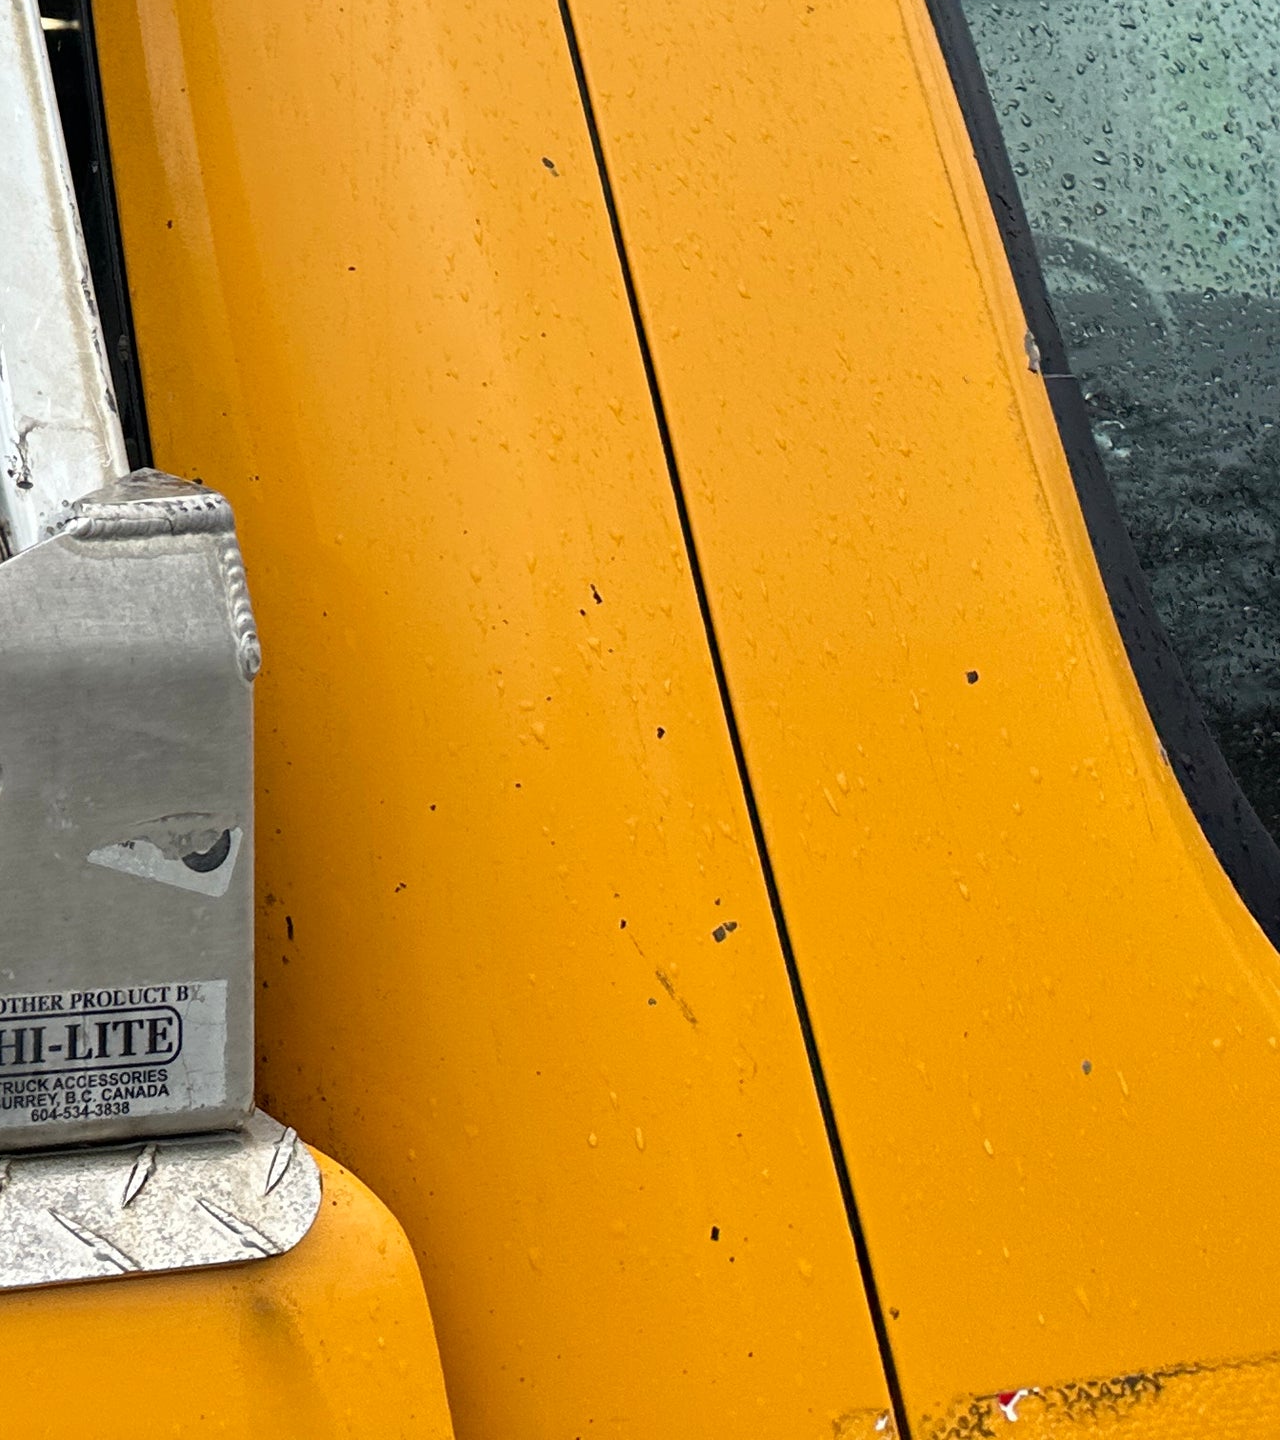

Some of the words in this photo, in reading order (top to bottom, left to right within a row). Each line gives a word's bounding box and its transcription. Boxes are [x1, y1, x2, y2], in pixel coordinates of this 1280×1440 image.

[70, 986, 172, 1009] PRODUCT
[52, 1068, 169, 1092] ACCESSORIES
[64, 1089, 98, 1105] B.C.
[101, 1083, 171, 1102] CANADA
[30, 1101, 131, 1123] 604-534-3838
